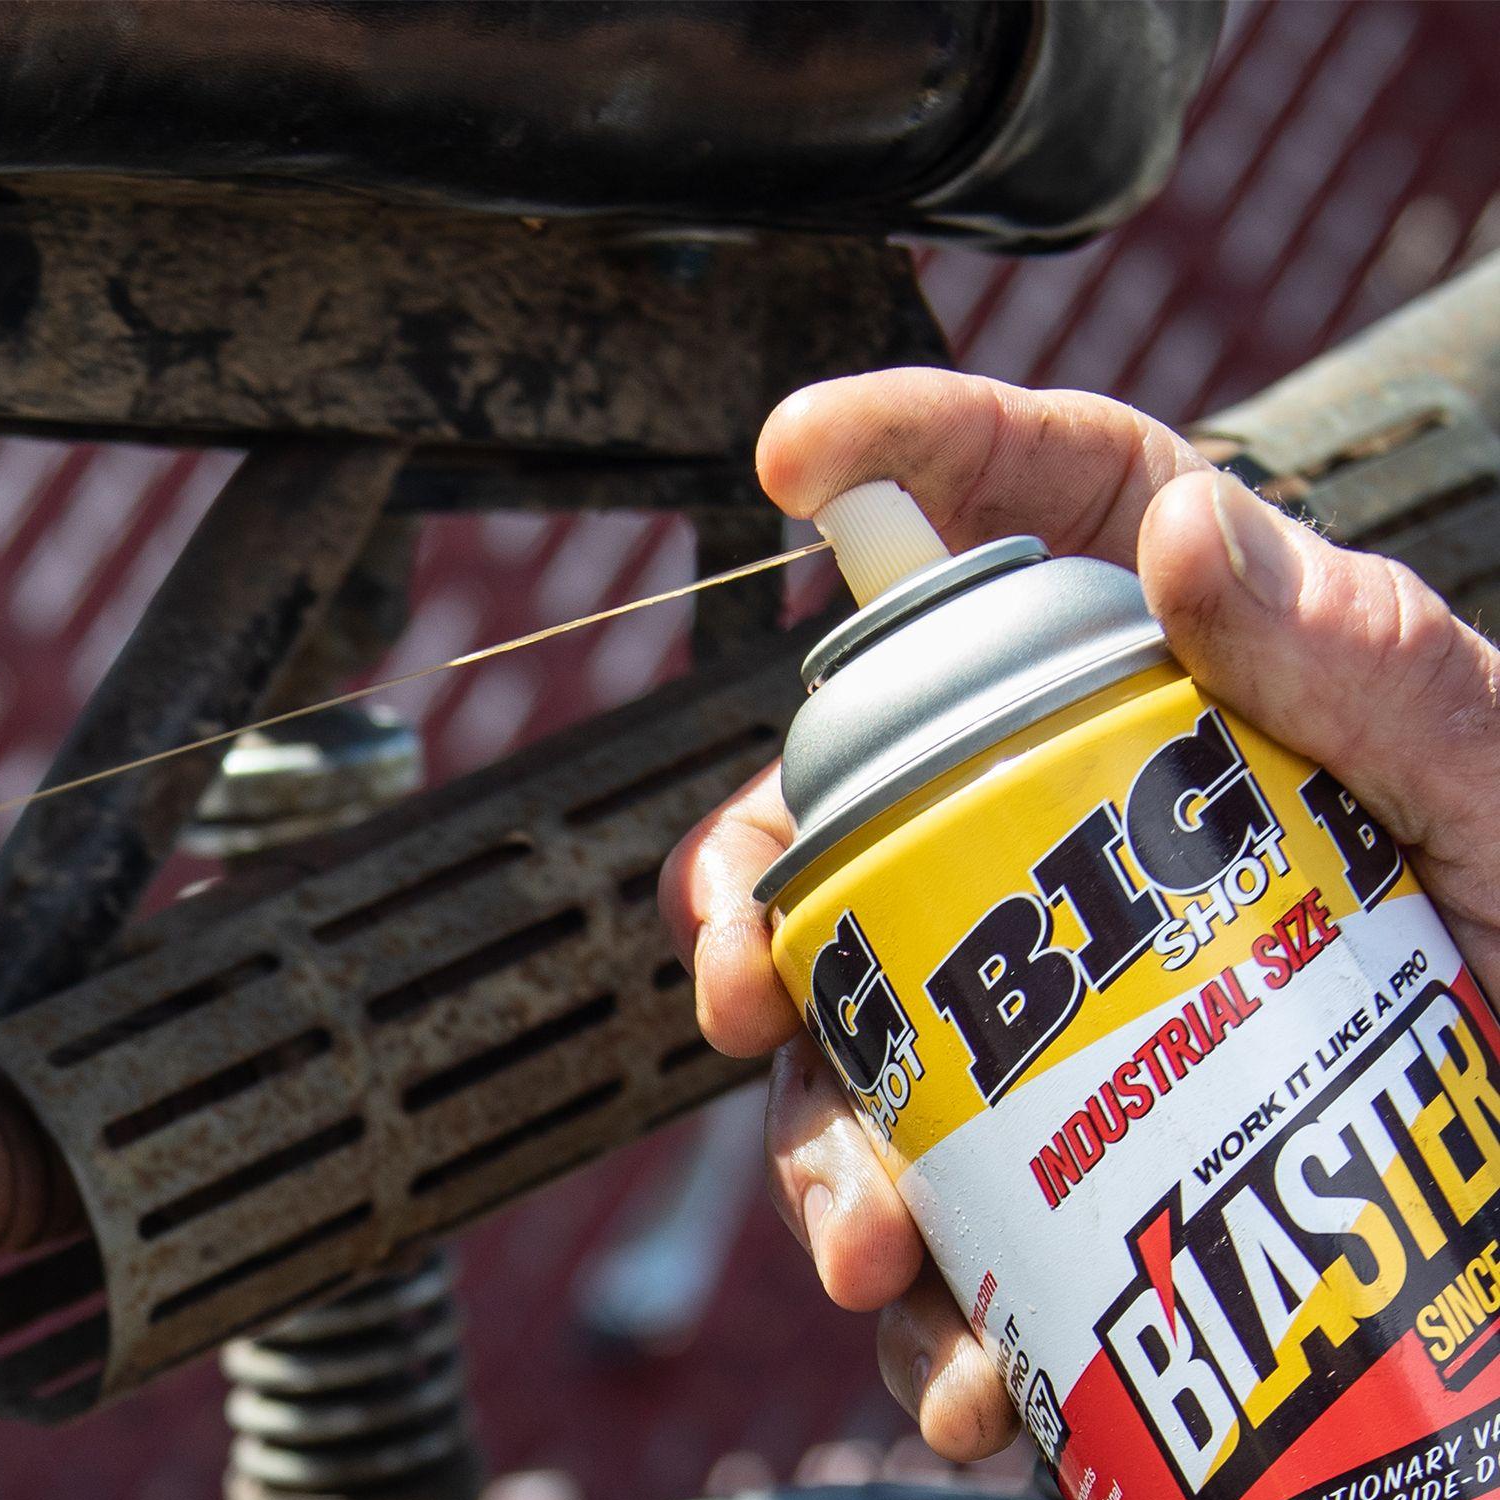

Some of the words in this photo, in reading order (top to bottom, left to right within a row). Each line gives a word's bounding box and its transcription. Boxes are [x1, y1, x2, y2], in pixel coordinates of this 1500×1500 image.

[922, 705, 1285, 1108] BIG
[1152, 828, 1291, 971] SHOT
[1029, 967, 1262, 1210] INDUSTRIAL
[1251, 887, 1341, 990] SIZE
[1192, 1091, 1286, 1185] WORK
[1284, 1062, 1312, 1100] IT
[1315, 1007, 1373, 1072] LIKE
[1374, 991, 1392, 1018] A
[1389, 949, 1428, 998] PRO
[996, 1338, 1012, 1384] ING
[1005, 1313, 1020, 1346] IT
[1415, 1239, 1500, 1361] SINCE
[1010, 1350, 1029, 1399] PRO
[1027, 1375, 1062, 1462] 1957
